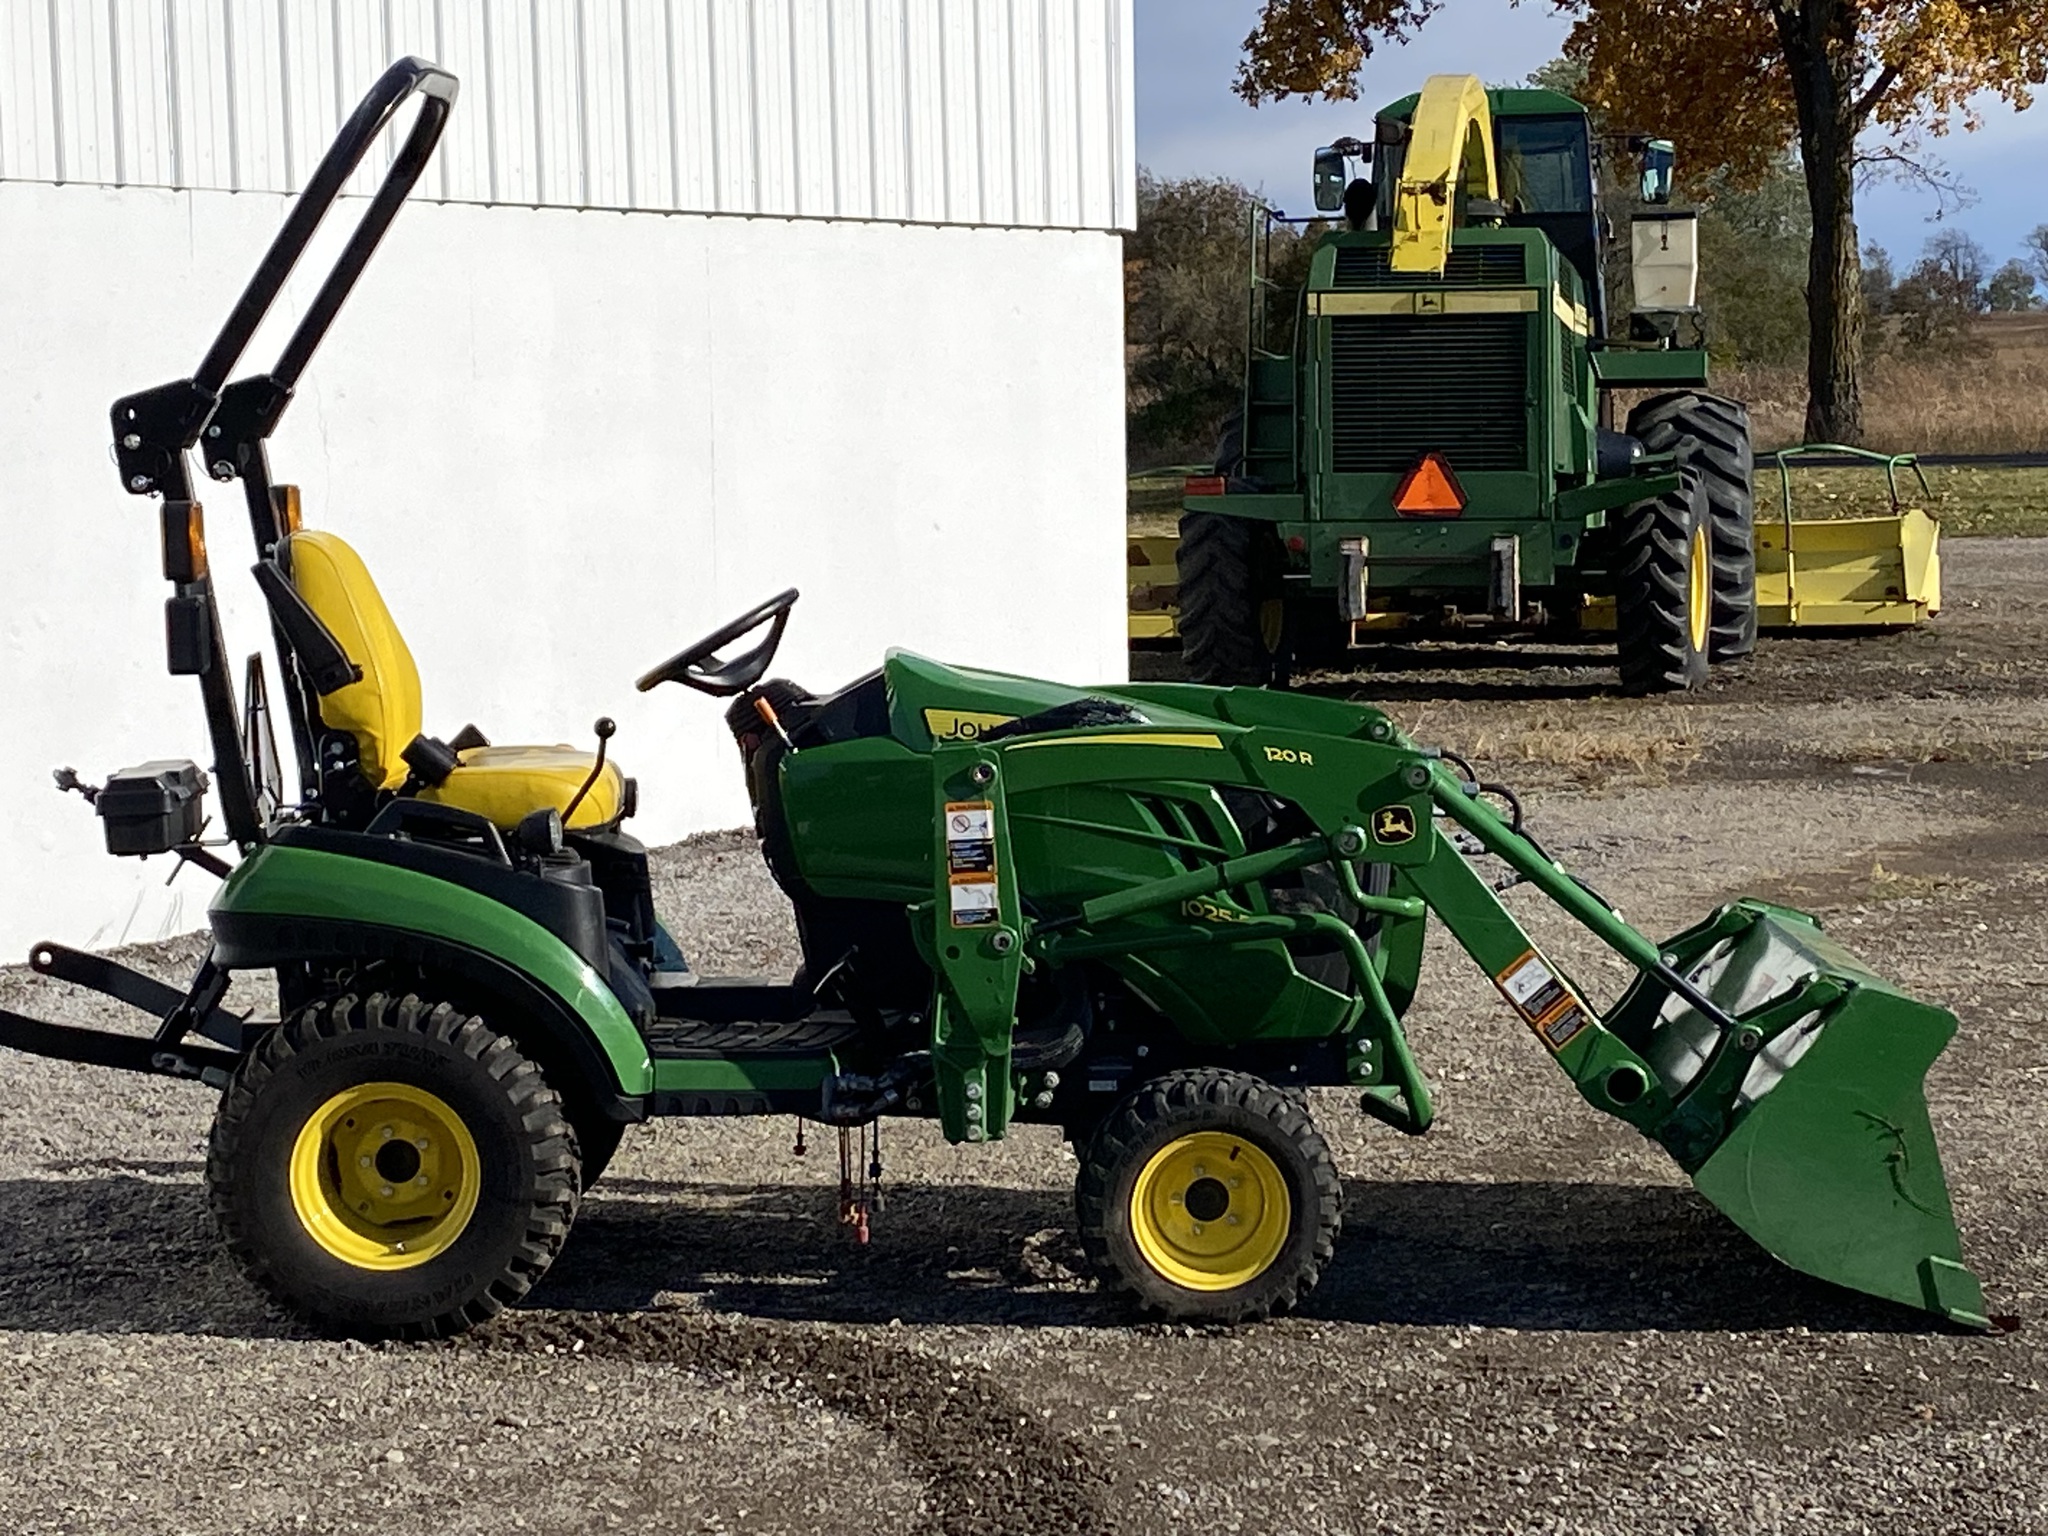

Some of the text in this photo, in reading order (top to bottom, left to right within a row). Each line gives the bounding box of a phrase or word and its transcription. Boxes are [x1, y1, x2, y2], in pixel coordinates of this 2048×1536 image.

[1263, 746, 1314, 766] 120 R
[1181, 900, 1249, 922] 1025
